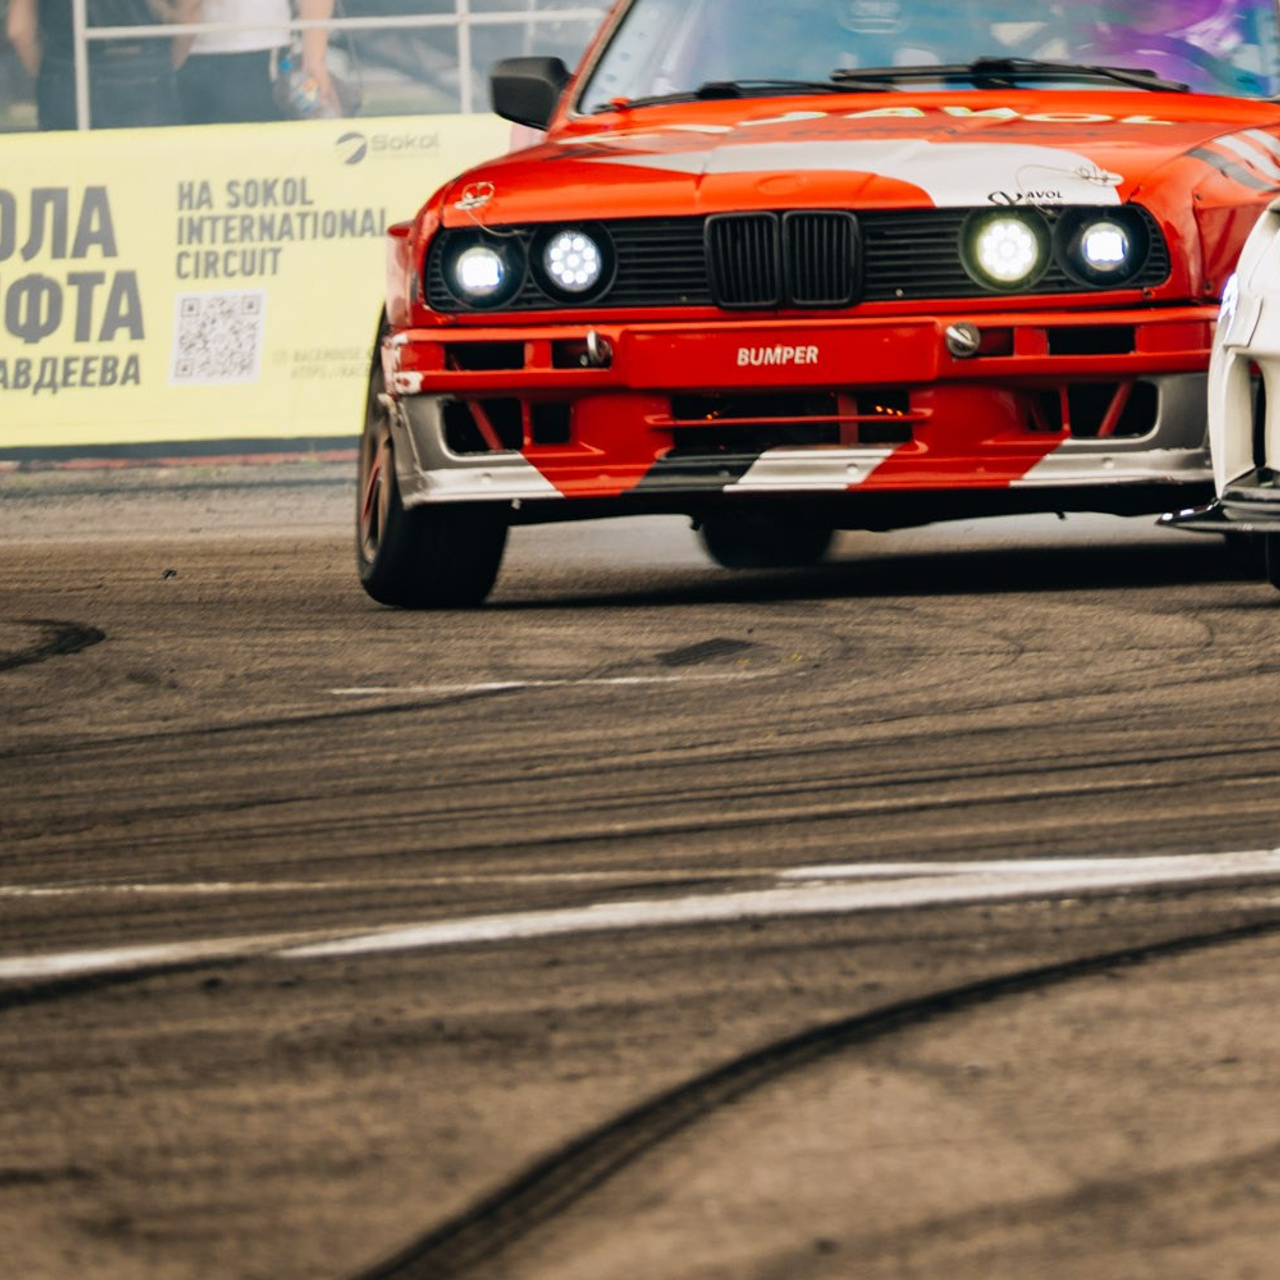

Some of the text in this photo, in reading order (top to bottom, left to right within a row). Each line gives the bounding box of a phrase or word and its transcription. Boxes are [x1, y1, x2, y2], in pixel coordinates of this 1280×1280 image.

[226, 177, 314, 208] SOKOL
[176, 247, 282, 280] CIRCUIT
[737, 345, 819, 366] BUMPER
